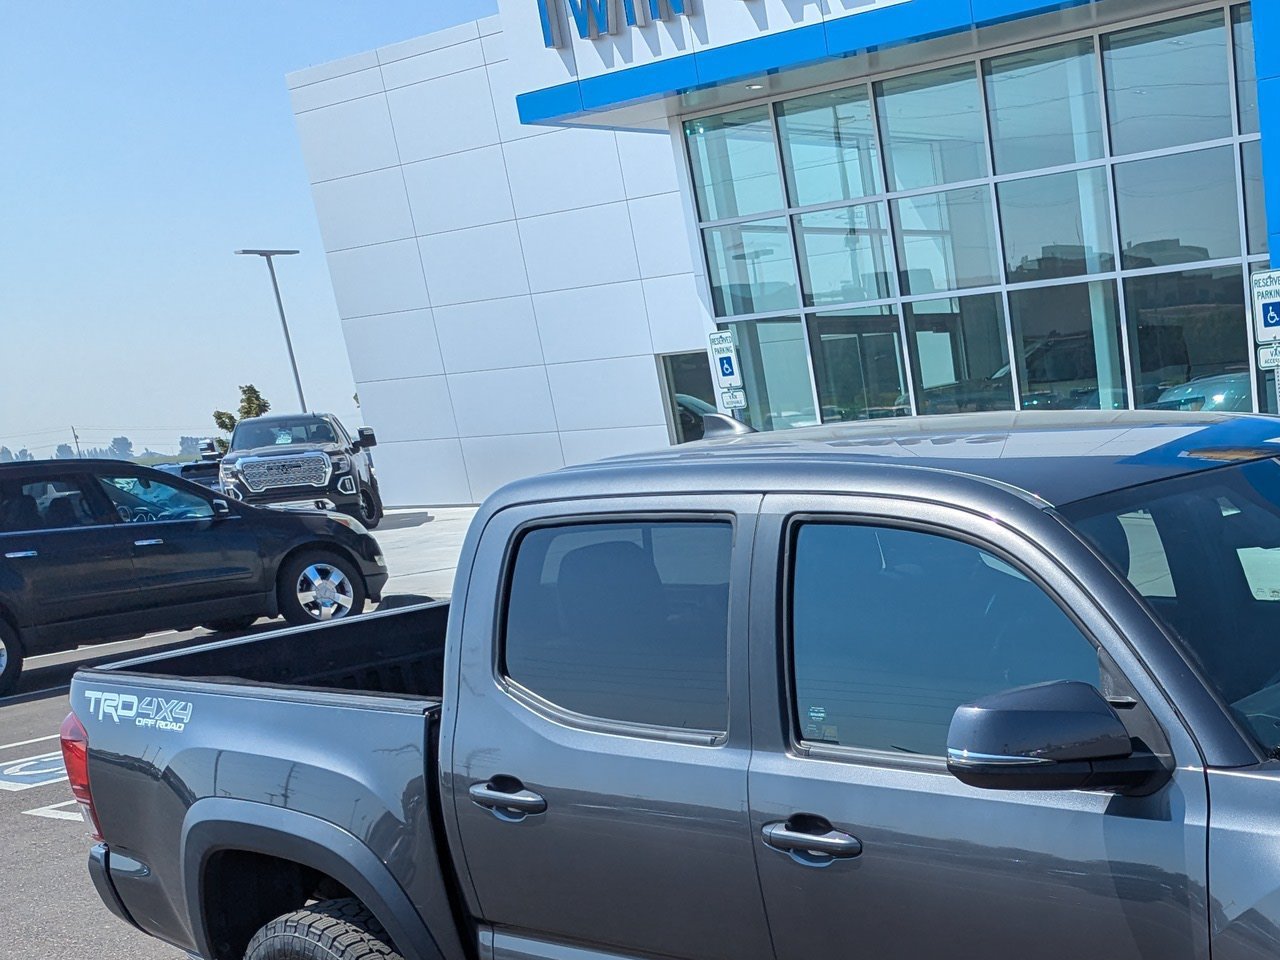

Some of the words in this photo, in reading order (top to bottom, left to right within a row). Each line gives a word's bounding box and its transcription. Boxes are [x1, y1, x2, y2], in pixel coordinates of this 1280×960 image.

[714, 346, 733, 355] PARKING
[85, 690, 138, 722] TRD
[135, 717, 155, 728] OFF
[156, 720, 185, 732] ROAD
